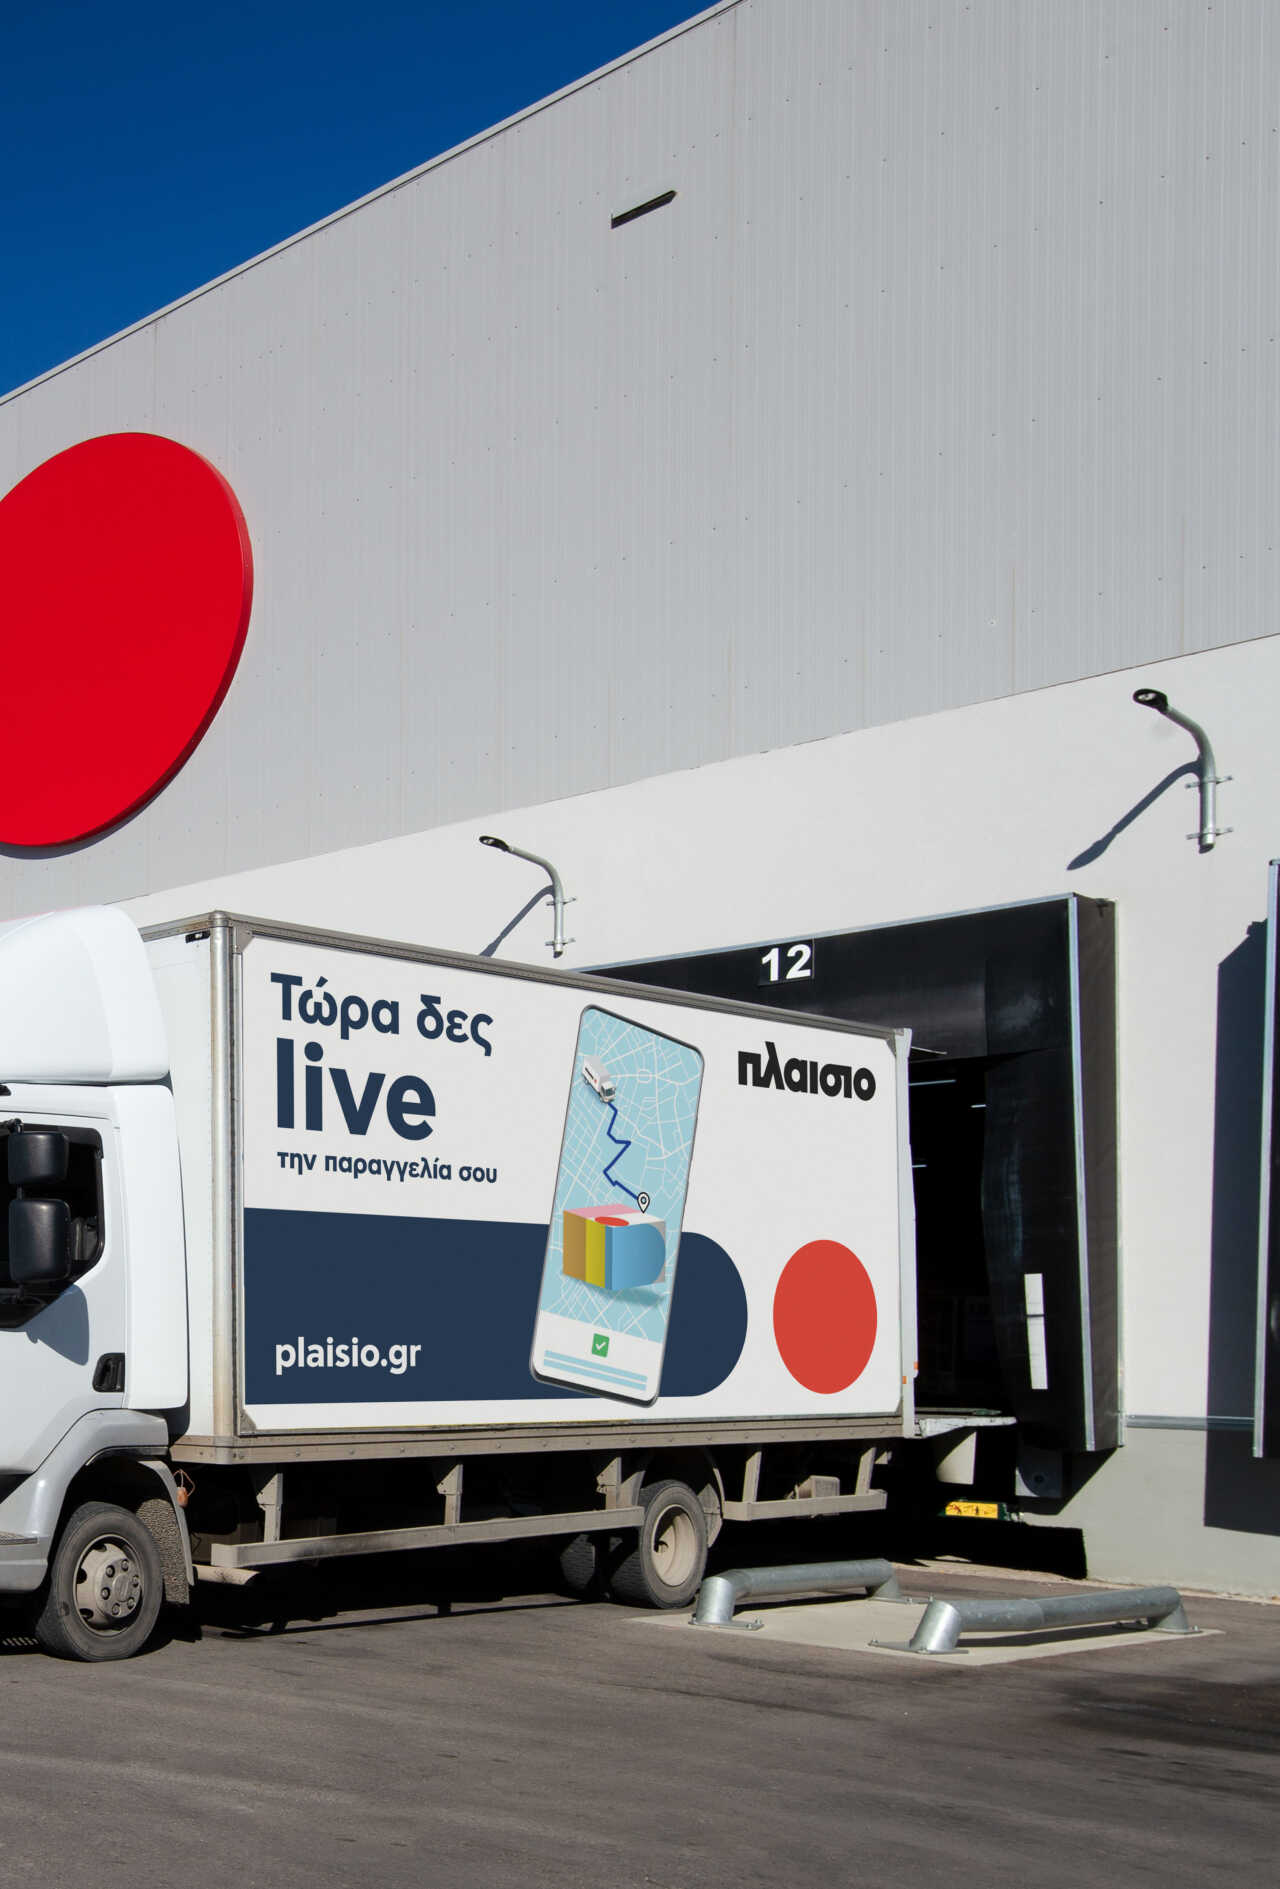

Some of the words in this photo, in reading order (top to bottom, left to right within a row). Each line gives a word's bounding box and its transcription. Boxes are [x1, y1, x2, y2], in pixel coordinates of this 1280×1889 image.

[761, 943, 813, 982] 12
[270, 972, 400, 1040] Τώρα
[416, 993, 494, 1057] δες
[276, 1038, 437, 1141] live
[276, 1151, 317, 1176] την
[324, 1155, 452, 1183] παραγγελία
[458, 1166, 498, 1184] σου
[275, 1336, 422, 1376] plaisio.gr
